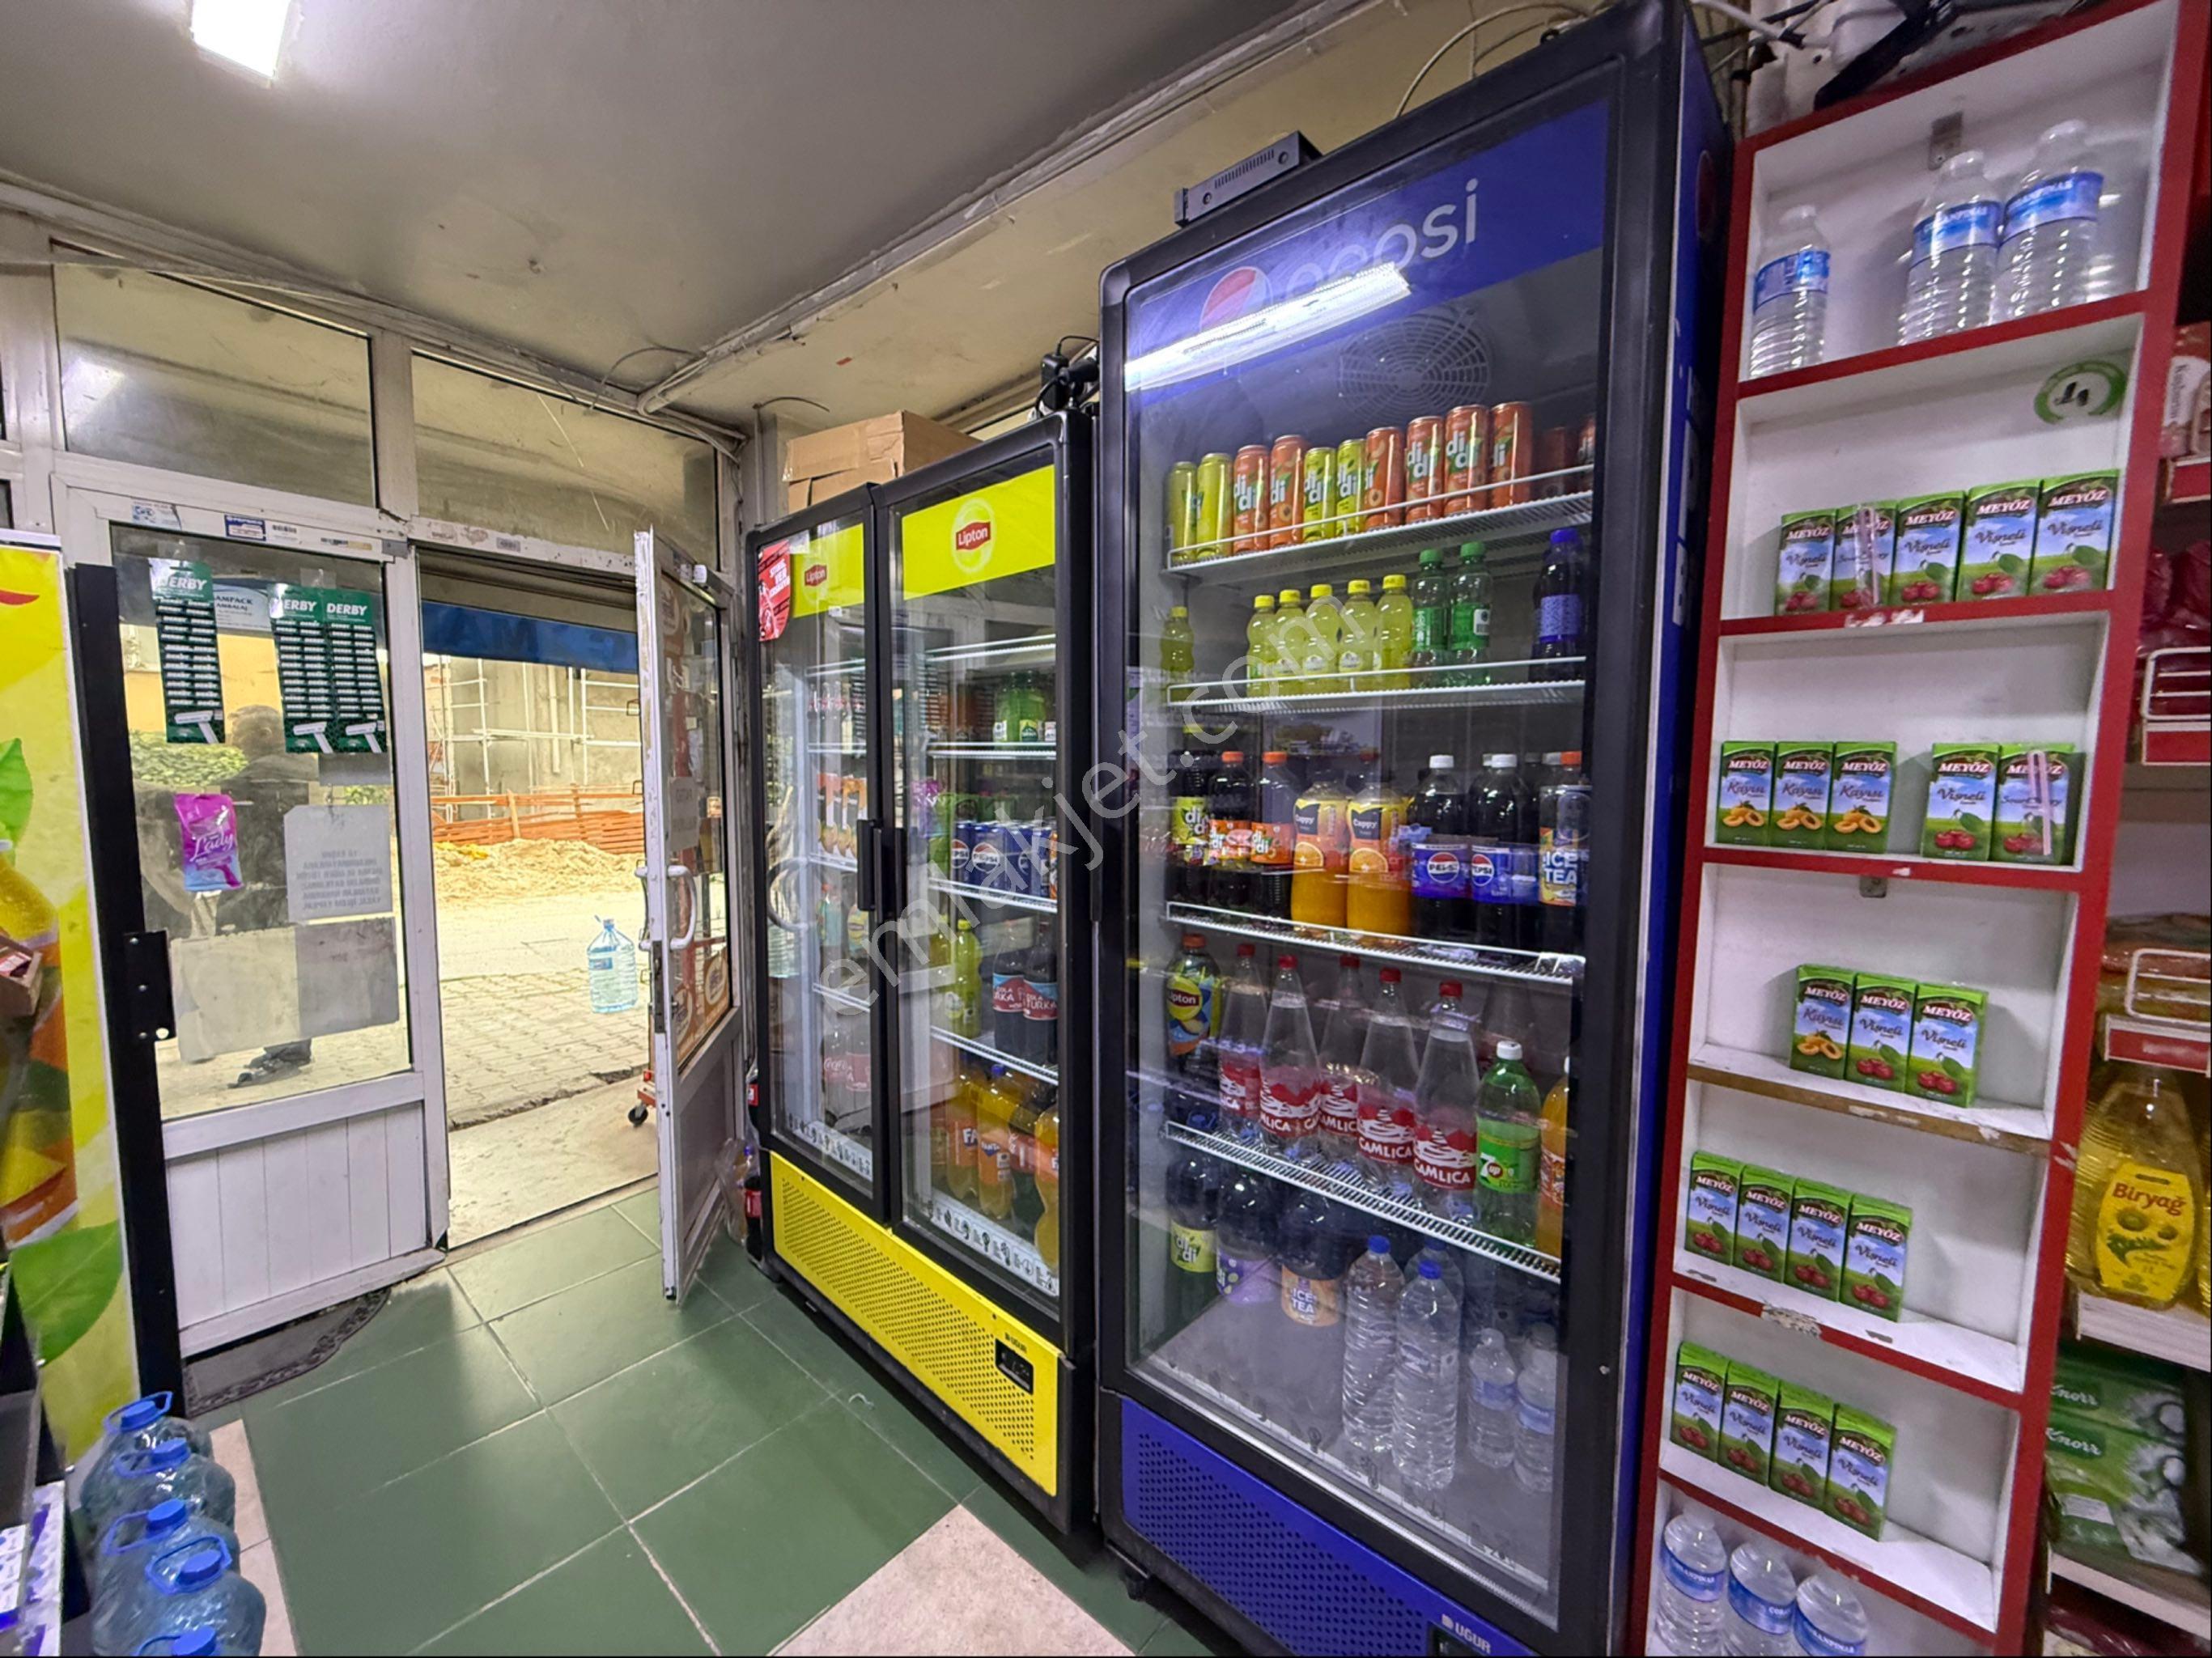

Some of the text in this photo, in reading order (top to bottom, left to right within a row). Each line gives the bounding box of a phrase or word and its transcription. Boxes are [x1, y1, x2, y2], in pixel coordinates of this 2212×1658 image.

[1843, 519, 1891, 535] MÖZ
[957, 526, 988, 547] Lipton
[282, 599, 368, 617] ERBY DERBY
[1353, 819, 1377, 829] Cappy
[1545, 850, 1577, 867] ICE
[1543, 869, 1577, 884] TEA
[2112, 1182, 2187, 1216] Biryağ
